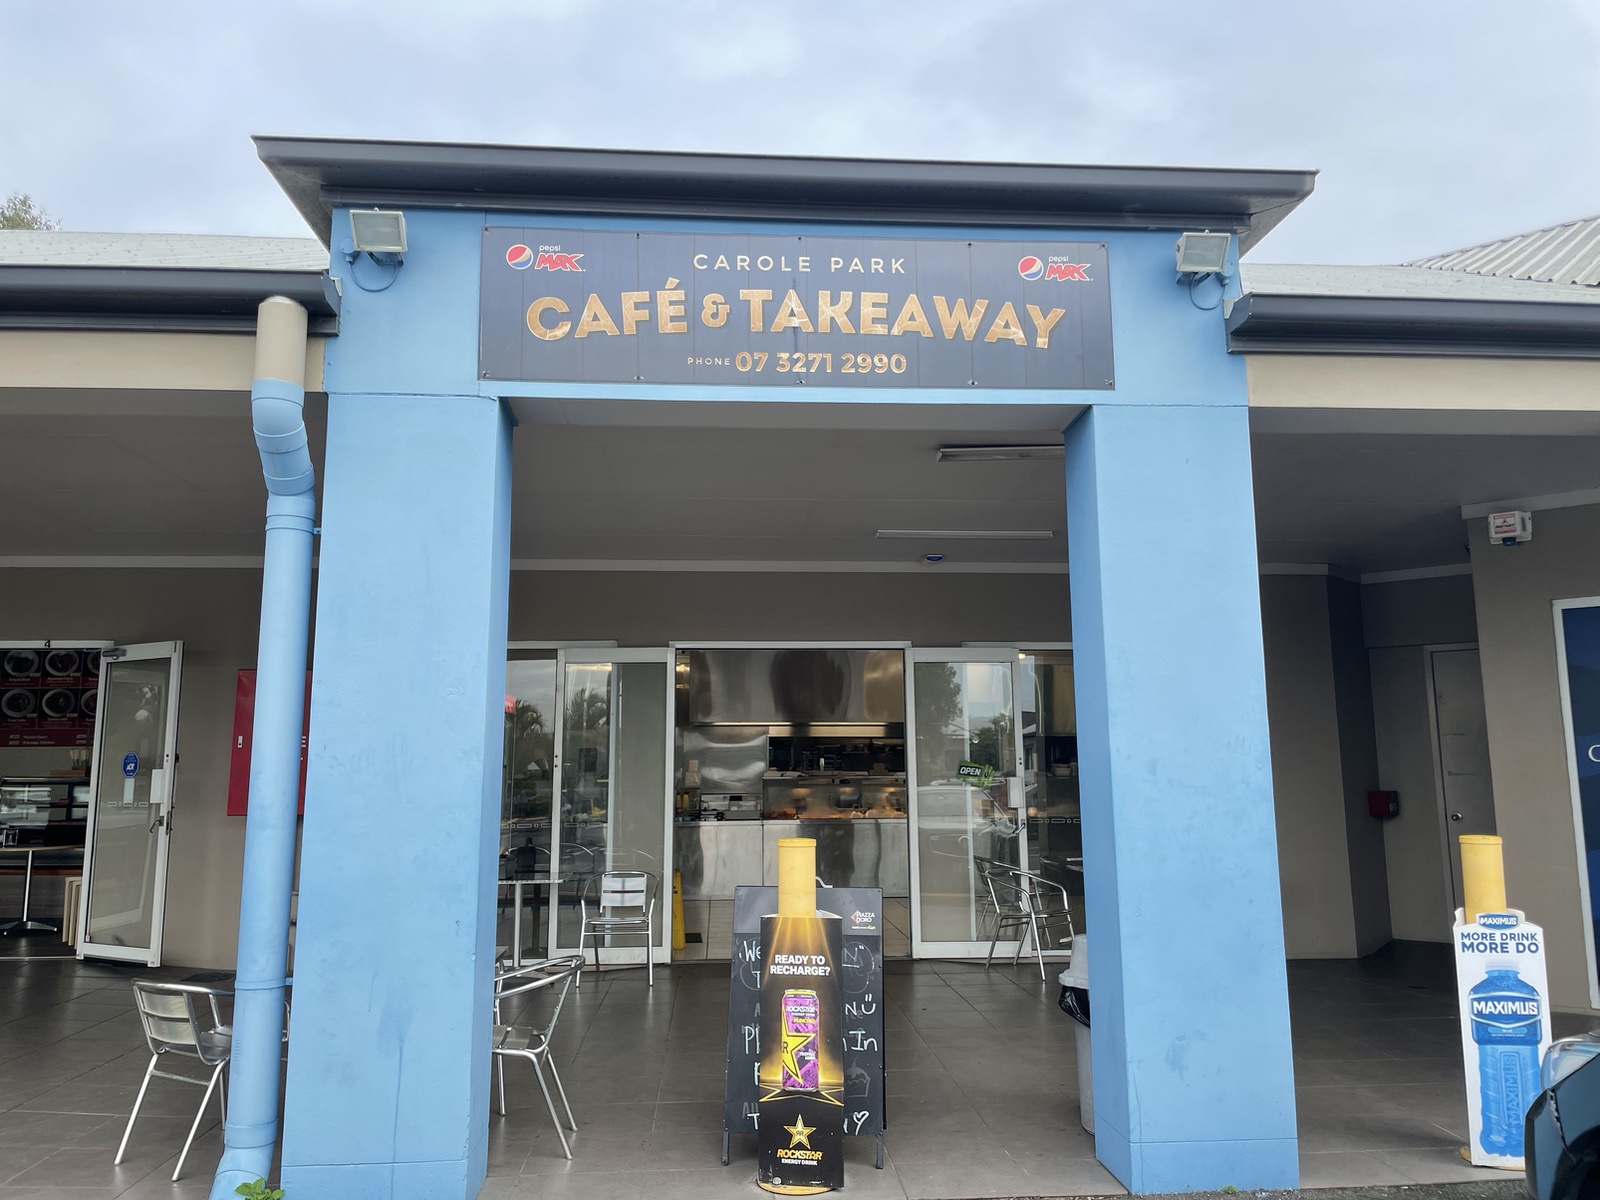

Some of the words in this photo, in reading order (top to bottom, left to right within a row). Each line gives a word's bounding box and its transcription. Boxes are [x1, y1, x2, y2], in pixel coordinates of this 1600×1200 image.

[535, 252, 585, 271] MAX
[693, 254, 811, 272] CAROLE
[831, 257, 905, 274] PARK
[1045, 263, 1092, 281] MAX
[526, 277, 688, 341] CAFÉ
[701, 293, 730, 328] &
[739, 289, 1066, 348] TAKEAWAY
[687, 357, 731, 366] PHONE
[735, 351, 769, 372] 07
[776, 352, 832, 373] 3271
[841, 353, 907, 374] 2990
[44, 640, 51, 649] 4
[960, 766, 982, 776] OPEN
[1480, 916, 1517, 926] MAXIMUS
[1461, 932, 1496, 942] MORE
[1500, 932, 1539, 942] DRINK
[1461, 941, 1510, 954] MORE
[1516, 942, 1540, 954] DO
[774, 954, 809, 965] READY
[810, 955, 826, 965] TO
[770, 965, 831, 976] RECHARGE?
[1473, 1001, 1539, 1015] MAXIMUS
[777, 1149, 823, 1161] ROCKSTAR
